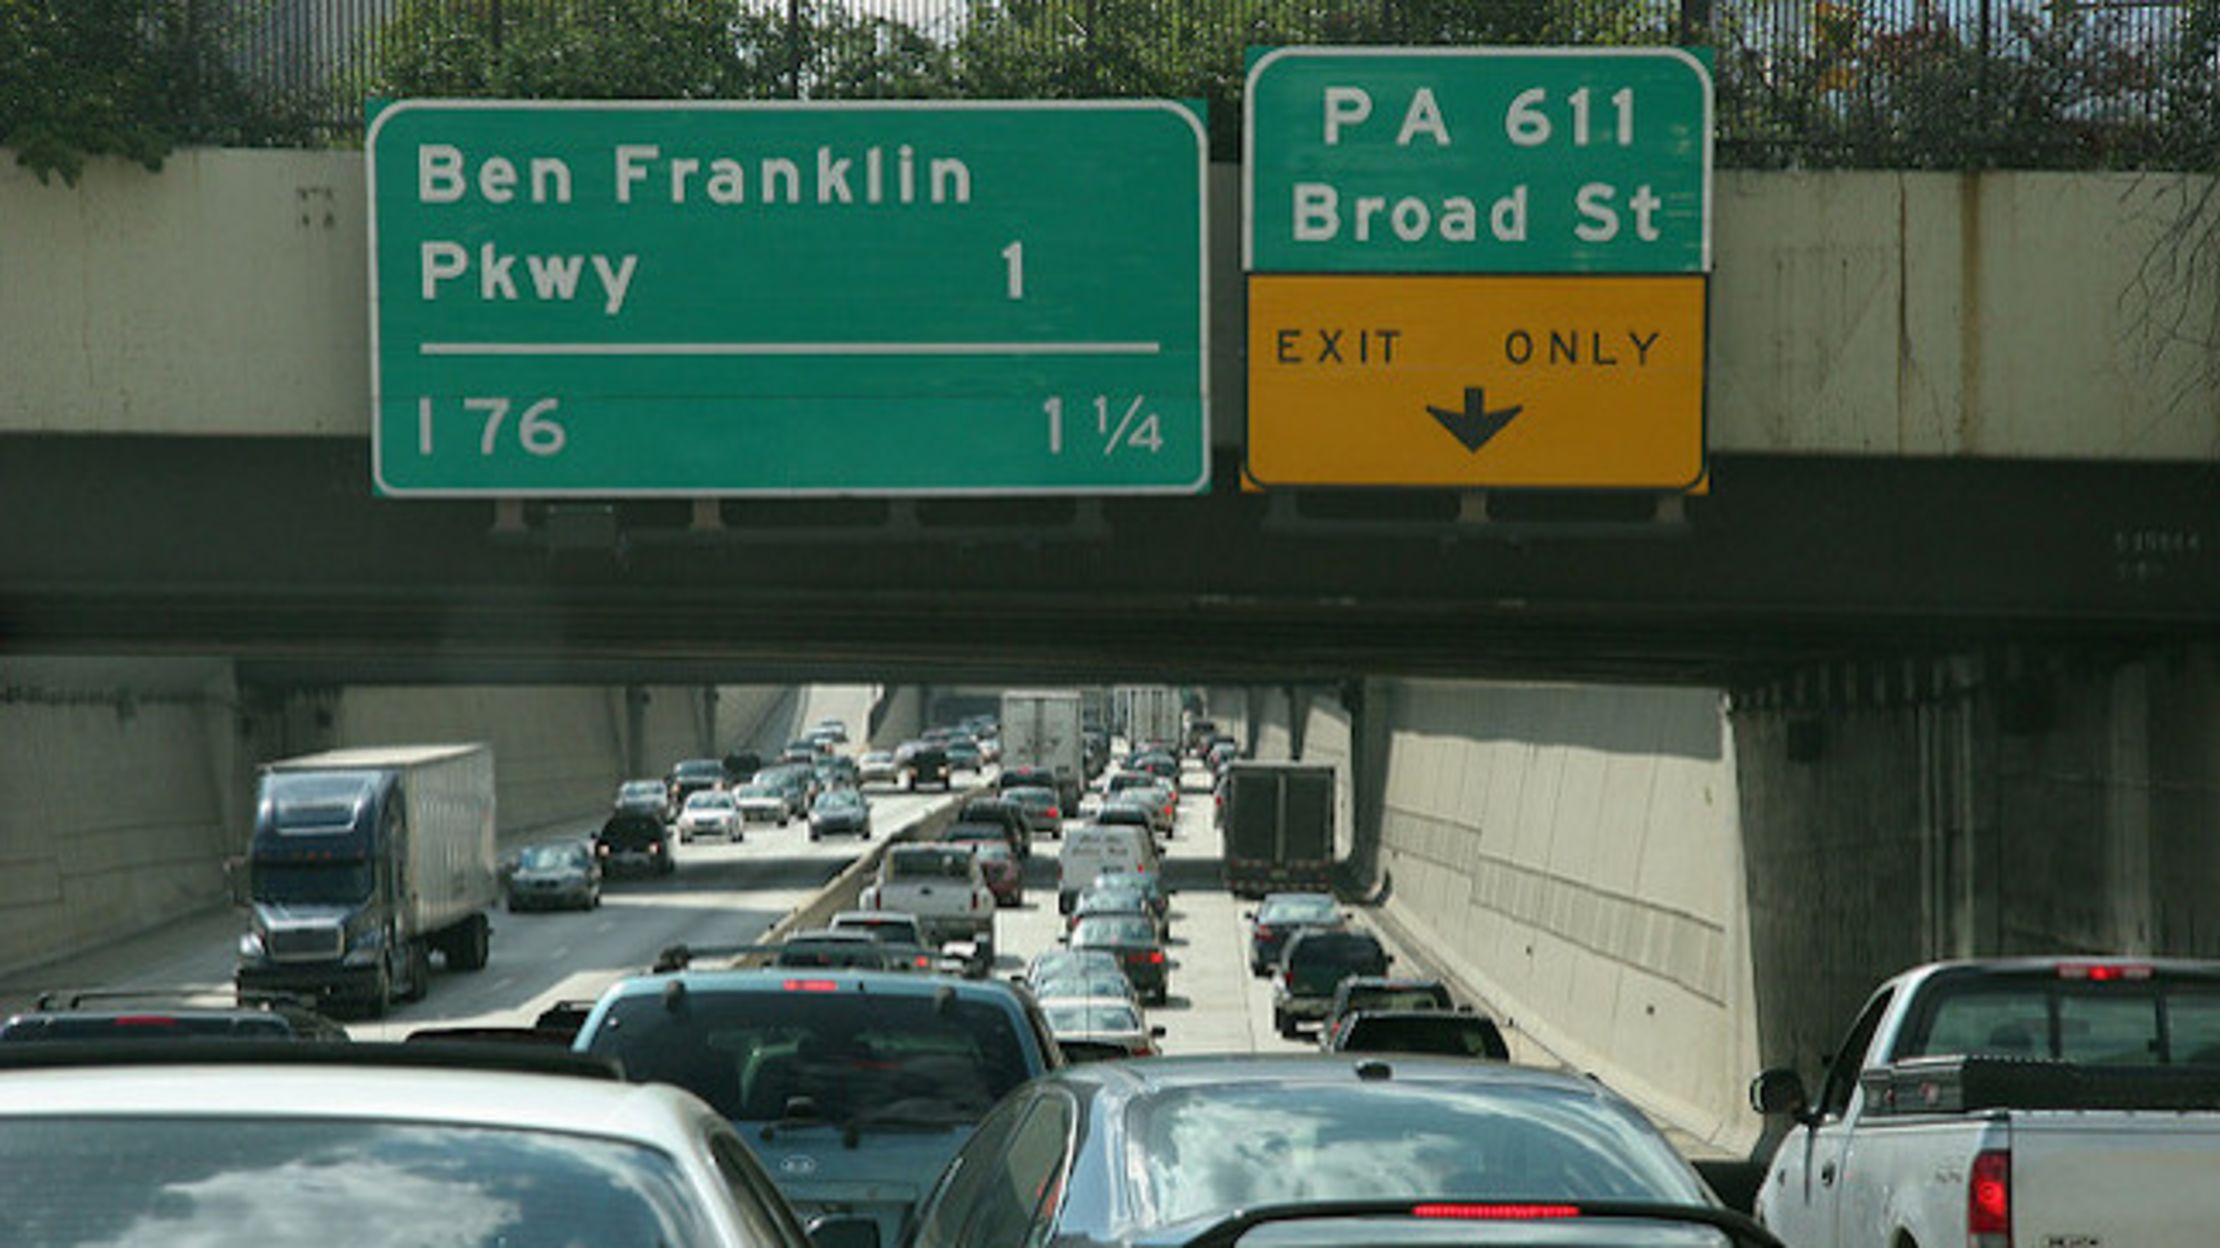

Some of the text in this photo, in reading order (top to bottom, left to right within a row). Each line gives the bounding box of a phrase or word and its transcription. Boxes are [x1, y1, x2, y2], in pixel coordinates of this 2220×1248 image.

[1324, 86, 1633, 147] PA 611
[419, 144, 970, 204] Ben Franklin
[1293, 182, 1661, 242] Broad St
[421, 241, 1023, 315] Pkwy 1
[1277, 329, 1659, 366] EXIT ONLY
[419, 397, 433, 454] I
[464, 397, 566, 456] 76
